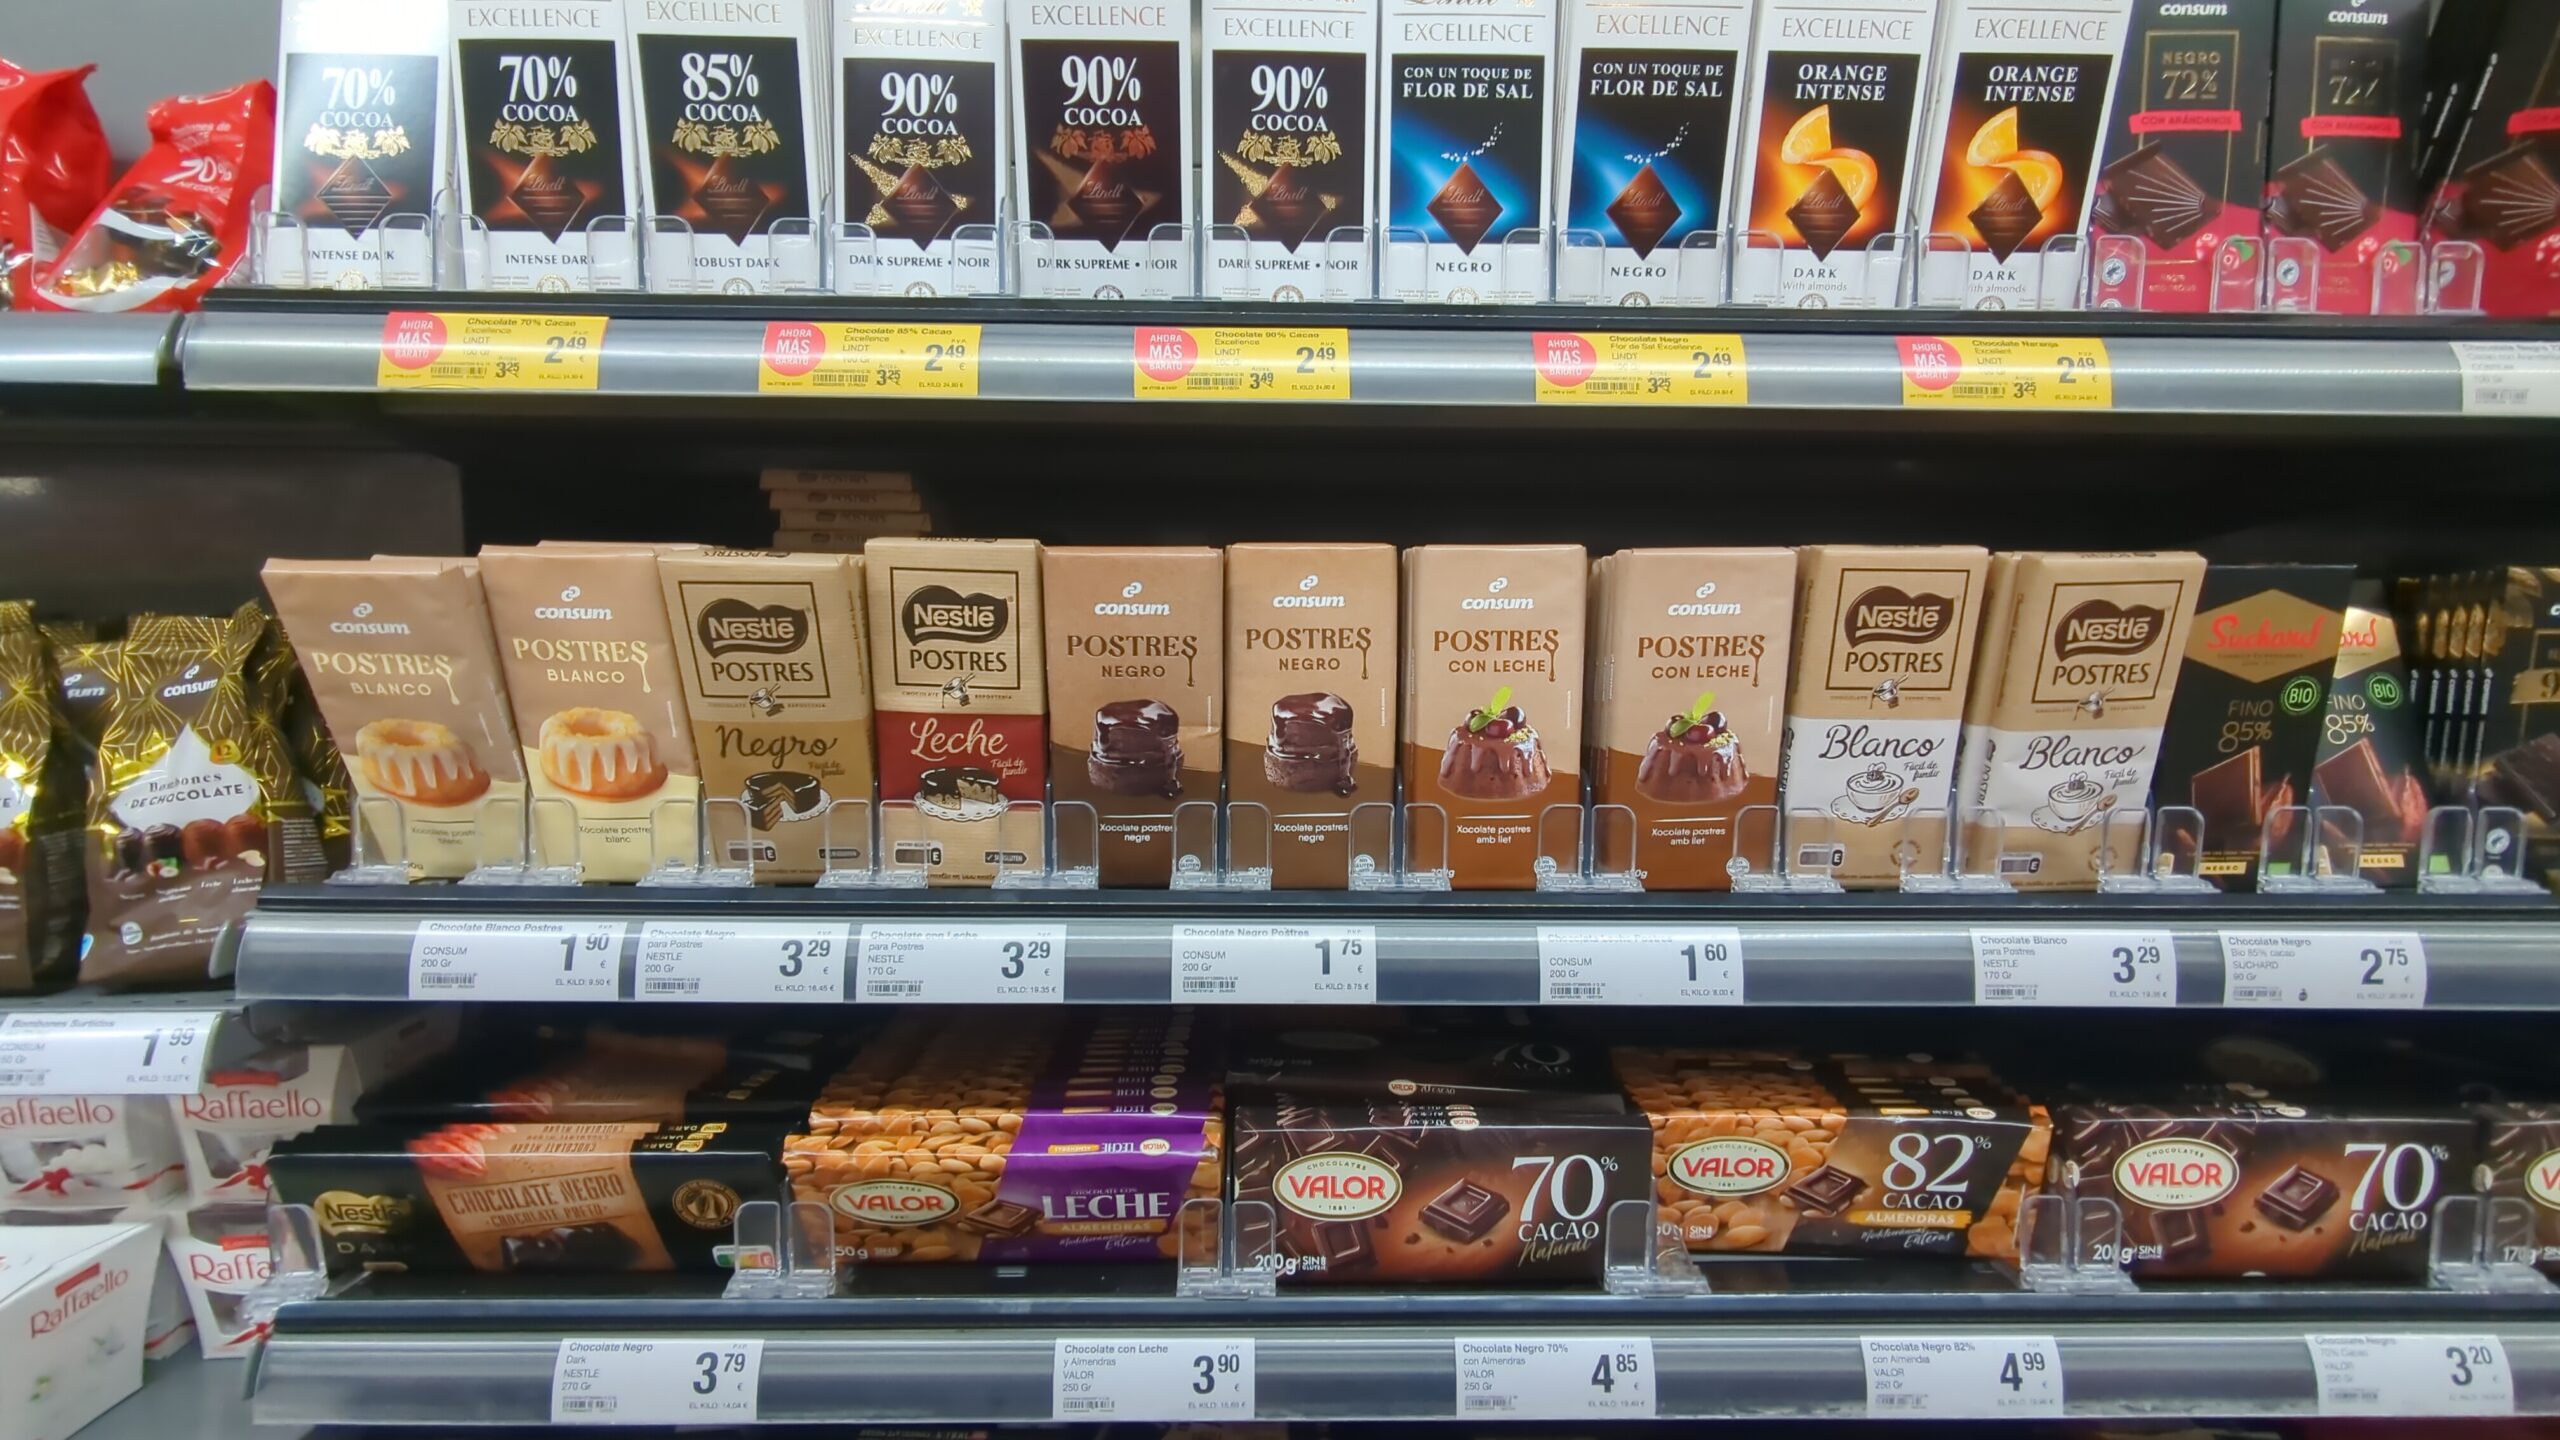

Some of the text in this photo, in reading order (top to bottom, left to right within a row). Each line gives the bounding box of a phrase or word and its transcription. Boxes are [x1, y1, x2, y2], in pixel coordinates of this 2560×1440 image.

[468, 8, 600, 28] EXCELLENCE
[1032, 4, 1166, 27] EXCELLENCE
[2160, 2, 2227, 17] consum
[2328, 9, 2388, 25] consum
[1224, 17, 1354, 39] EXCELLENCE
[1403, 23, 1534, 43] EXCELLENCE
[1595, 14, 1731, 37] EXCELLENCE
[1782, 17, 1913, 41] EXCELLENCE
[1974, 18, 2108, 42] EXCELLENCE
[854, 27, 983, 50] EXCELLENCE
[2161, 51, 2221, 65] NEGRO
[682, 52, 759, 101] 85%
[1403, 66, 1532, 81] CON UN TOQUE DE
[1592, 62, 1724, 77] CON UN TOQUE DE
[1799, 64, 1888, 83] ORANGE
[1989, 65, 2078, 83] ORANGE
[322, 67, 395, 109] 70%
[499, 56, 577, 102] 70%
[1062, 55, 1141, 105] 90%
[1590, 79, 1723, 97] FLOR DE SAL
[2161, 70, 2218, 99] 72%
[881, 72, 957, 117] 90%
[1251, 65, 1328, 112] 90%
[1402, 82, 1533, 99] FLOR DE SAL
[1795, 83, 1886, 101] INTENSE
[1985, 85, 2075, 103] INTENSE
[320, 111, 394, 128] COCOA
[502, 104, 579, 122] COCOA
[685, 103, 762, 122] COCOA
[1064, 108, 1142, 126] COCOA
[882, 118, 958, 135] COCOA
[1251, 114, 1328, 132] COCOA
[1255, 259, 1311, 271] SUPREME
[1435, 262, 1492, 273] NEGRO
[1610, 266, 1666, 278] NEGRO
[1793, 267, 1838, 279] DARK
[1972, 269, 2016, 281] DARK
[1782, 281, 1848, 292] With almonds
[779, 328, 811, 338] AHORA
[846, 327, 895, 335] Chocolate
[921, 328, 952, 336] Cacao
[1150, 334, 1182, 343] AHORA
[1660, 336, 1689, 344] Negro
[776, 338, 810, 354] MÁS
[1912, 343, 1944, 351] AHORA
[924, 344, 943, 371] 2
[1296, 347, 1315, 374] 2
[1095, 603, 1170, 617] consum
[1273, 595, 1345, 609] consum
[1461, 596, 1534, 610] consum
[1667, 601, 1742, 616] consum
[534, 606, 613, 621] consum
[914, 603, 995, 628] Nestlé
[1857, 605, 1940, 628] Nestlé
[330, 620, 410, 635] consum
[708, 617, 795, 641] Nestlé
[2066, 616, 2150, 641] Nestlé
[2207, 614, 2326, 649] Suchard
[1067, 635, 1198, 658] POSTRES
[1246, 627, 1372, 651] POSTRES
[1433, 629, 1560, 652] POSTRES
[1637, 635, 1765, 659] POSTRES
[512, 638, 648, 665] POSTRES
[311, 651, 453, 677] POSTRES
[910, 650, 1007, 673] POSTRES
[1279, 658, 1341, 670] NEGRO
[1448, 660, 1546, 673] CON LECHE
[1845, 652, 1943, 673] POSTRES
[547, 669, 625, 684] BLANCO
[711, 662, 814, 682] POSTRES
[1102, 665, 1166, 678] NEGRO
[1652, 665, 1749, 679] CON LECHE
[2052, 663, 2151, 686] POSTRES
[164, 677, 218, 697] consum
[350, 681, 432, 696] BLANCO
[2289, 688, 2312, 704] BIO
[2373, 683, 2395, 699] BIO
[2229, 701, 2273, 717] FINO
[2218, 721, 2272, 753] 85%
[2325, 714, 2375, 744] 85%
[715, 724, 838, 770] Negro
[910, 718, 1007, 762] Leche
[1819, 724, 1945, 759] Blanco
[2019, 735, 2145, 770] Blanco
[149, 784, 244, 806] CHOCOLATE
[1273, 823, 1349, 834] Xocolate postres
[1298, 833, 1325, 843] negre
[1981, 936, 2068, 945] Chocolate Blanco
[423, 947, 467, 955] CONSUM
[646, 952, 683, 960] NESTLE
[1001, 941, 1025, 978] 3
[1183, 951, 1226, 960] CONSUM
[1182, 963, 1212, 971] 200 Gr
[2361, 949, 2384, 985] 2
[181, 1091, 322, 1120] Raffaello
[1682, 1157, 1774, 1178] VALOR
[2128, 1162, 2222, 1187] VALOR
[446, 1174, 625, 1216] CHOCOLATE NEGRO
[1287, 1175, 1386, 1200] VALOR
[843, 1195, 946, 1212] VALOR
[1041, 1192, 1171, 1219] LECHE
[1883, 1193, 1963, 1209] CACAO
[1061, 1222, 1151, 1232] ALMENDRAS
[1865, 1213, 1955, 1225] ALMENDRAS
[2349, 1212, 2427, 1232] CACAO
[1518, 1222, 1599, 1242] CACAO
[31, 1268, 129, 1339] Raffaello
[569, 1343, 653, 1353] Chocolate Negro
[1065, 1345, 1168, 1354] Chocolate con Leche
[1463, 1344, 1569, 1355] Chocolate Negro 70%
[1192, 1355, 1215, 1394] 3
[2446, 1347, 2472, 1386] 3
